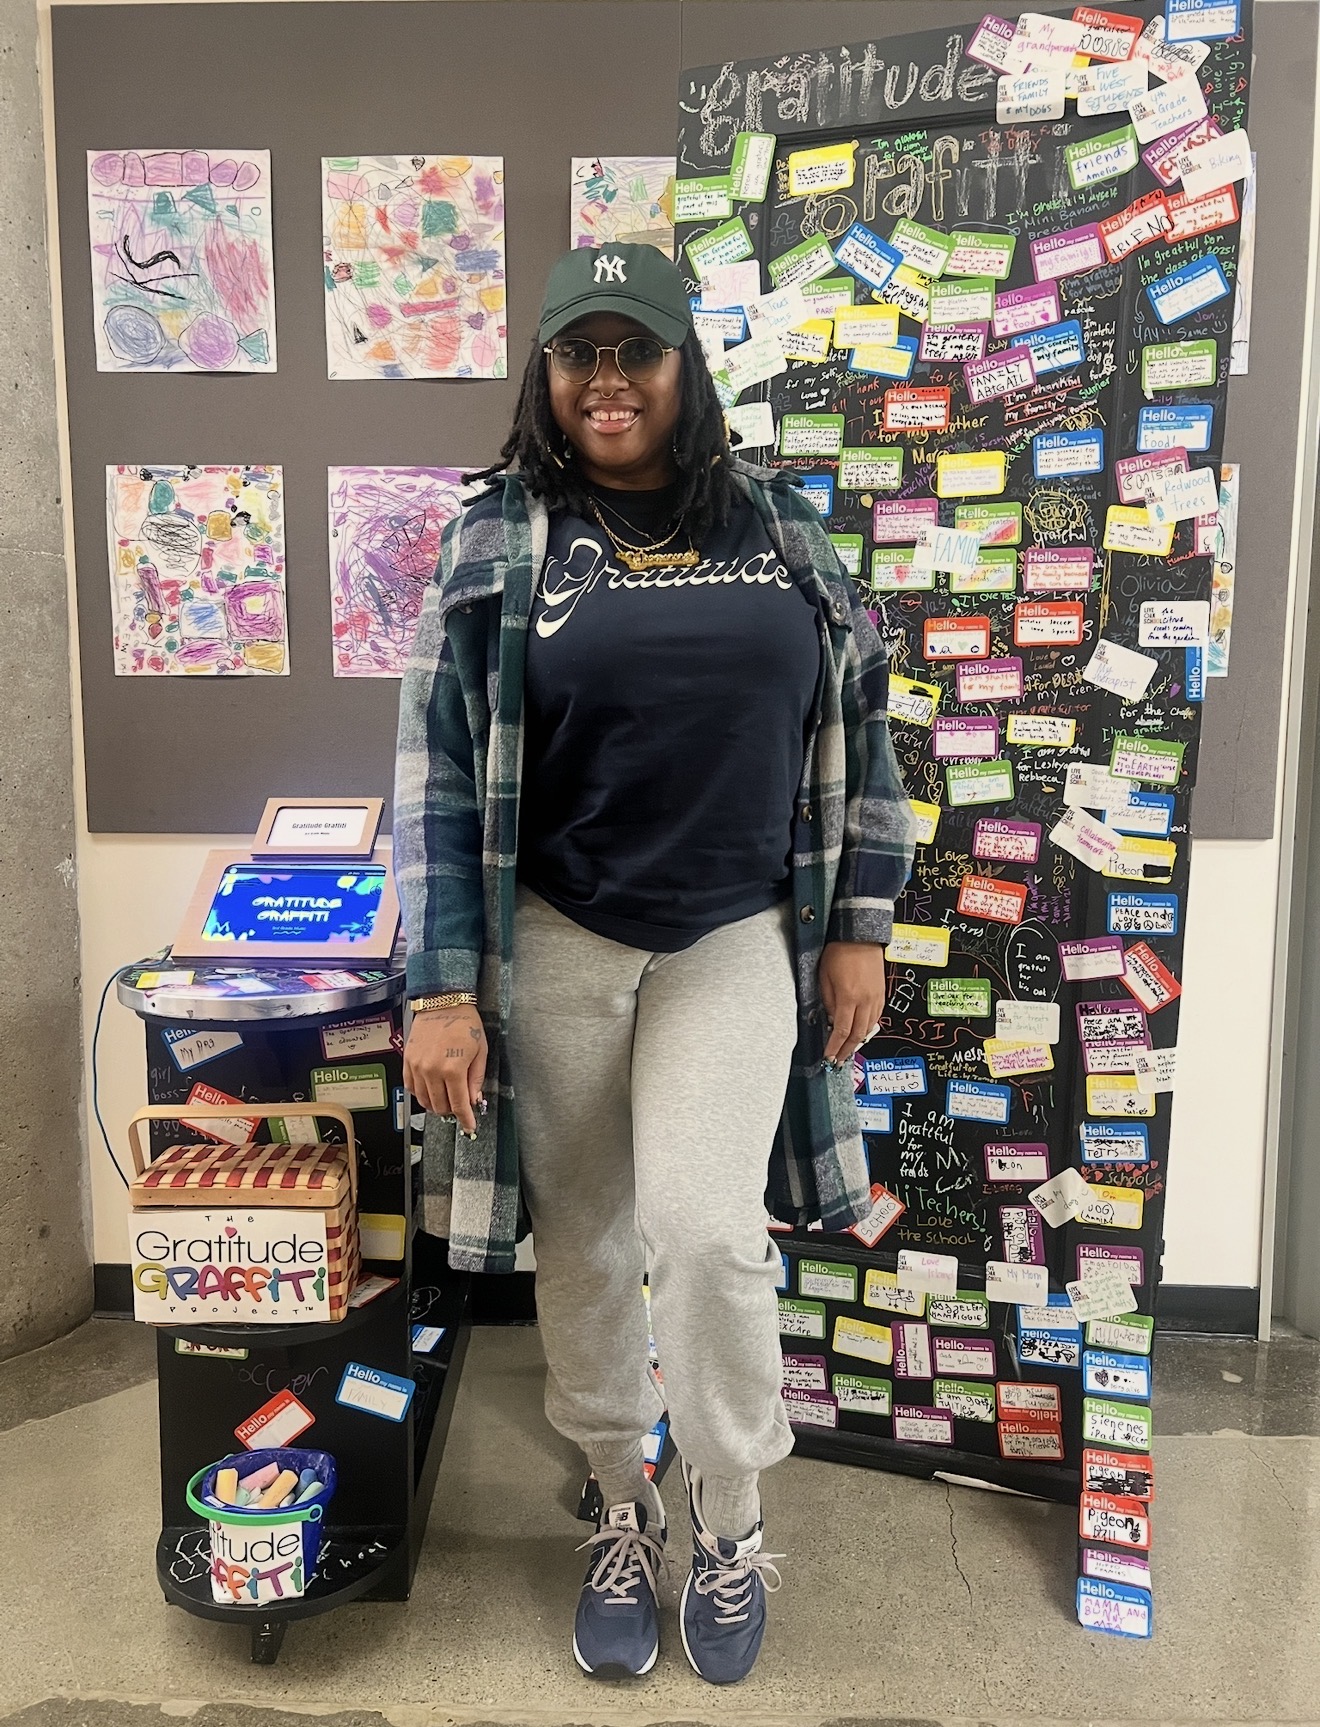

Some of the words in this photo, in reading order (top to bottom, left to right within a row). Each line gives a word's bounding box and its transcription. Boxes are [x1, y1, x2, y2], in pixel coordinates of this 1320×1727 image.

[1076, 11, 1108, 25] Hello
[983, 18, 1013, 39] Hello
[1039, 24, 1055, 39] My
[1013, 78, 1049, 91] FRIENDS
[1099, 77, 1129, 91] WEST
[1017, 88, 1048, 102] FAMILY
[1086, 87, 1145, 105] STUDENTS
[1014, 105, 1029, 114] MY
[1029, 105, 1052, 117] DOGS
[1158, 96, 1187, 113] Grade
[1151, 108, 1192, 130] Teachers
[1070, 139, 1102, 160] Hello
[1145, 136, 1178, 164] Hello
[1076, 147, 1128, 173] friends
[1209, 154, 1242, 170] Biking
[676, 182, 703, 193] Hello
[729, 165, 743, 196] Hello
[1025, 214, 1054, 229] Mini
[1060, 199, 1110, 223] Banana
[851, 228, 876, 249] Hello
[898, 223, 926, 240] Hello
[688, 236, 715, 255] Hello
[912, 244, 940, 259] grateful
[1034, 238, 1066, 254] Hello
[1138, 256, 1150, 271] I'm
[1204, 235, 1224, 246] for
[593, 253, 628, 284] NY
[772, 251, 799, 274] Hello
[1141, 274, 1159, 286] the
[1166, 260, 1188, 275] class
[931, 285, 962, 296] Hello
[1150, 277, 1183, 298] Hello
[995, 293, 1023, 309] Hello
[1013, 318, 1037, 328] food
[1177, 327, 1208, 341] Same
[1052, 344, 1079, 357] family
[1087, 352, 1102, 363] dog
[967, 361, 998, 376] Hello
[804, 378, 816, 387] my
[977, 374, 1028, 399] ABIGAIL
[888, 392, 917, 401] Hello
[1004, 393, 1027, 407] I'm
[1031, 376, 1081, 397] thankful
[1024, 401, 1057, 416] family
[1143, 410, 1176, 421] Hello
[786, 417, 814, 428] Hello
[878, 430, 900, 443] for
[1037, 437, 1068, 449] Hello
[1144, 434, 1176, 448] Food!
[842, 450, 872, 461] Hello
[1119, 460, 1151, 474] Hello
[1164, 471, 1211, 495] Redwood
[877, 503, 906, 514] Hello
[1170, 494, 1205, 512] trees
[875, 552, 904, 563] Hello
[1028, 552, 1059, 562] Hello
[535, 537, 794, 639] Gratitude
[1121, 575, 1187, 594] Olivia
[1018, 607, 1049, 616] Hello
[959, 663, 990, 676] Hello
[1189, 666, 1200, 698] Hello
[1037, 690, 1059, 704] my
[1119, 707, 1137, 719] for
[1144, 704, 1165, 716] the
[936, 720, 966, 731] Hello
[1133, 722, 1174, 738] grateful
[1117, 739, 1149, 751] Hello
[1016, 762, 1032, 771] for
[1131, 759, 1160, 772] EARTH
[949, 767, 979, 779] Hello
[978, 820, 1008, 833] Hello
[1076, 833, 1104, 856] teamwork
[1108, 853, 1144, 875] Pigeon
[917, 866, 940, 877] the
[252, 897, 342, 908] GRATITUDE
[1111, 895, 1144, 905] Hello
[256, 911, 330, 922] GRAFFITI
[1061, 944, 1090, 955] Hello
[1036, 954, 1051, 962] am
[930, 981, 959, 991] Hello
[180, 1046, 195, 1063] My
[866, 1060, 894, 1071] Hello
[151, 1066, 171, 1088] girl
[314, 1071, 349, 1083] Hello
[152, 1088, 180, 1100] boss
[950, 1082, 979, 1094] Hello
[901, 1103, 912, 1117] I
[927, 1111, 955, 1130] am
[898, 1121, 954, 1146] grateful
[907, 1138, 922, 1151] for
[987, 1146, 1017, 1156] Hello
[900, 1151, 924, 1169] my
[1053, 1189, 1063, 1201] My
[916, 1216, 953, 1227] Love
[897, 1228, 922, 1242] the
[926, 1231, 976, 1245] School
[136, 1226, 324, 1263] Gratitude
[1080, 1247, 1110, 1258] Hello
[802, 1262, 829, 1274] Hello
[921, 1257, 940, 1266] Love
[1006, 1269, 1019, 1280] My
[1022, 1270, 1042, 1280] Mom
[935, 1339, 964, 1350] Hello
[896, 1349, 907, 1376] Hello
[1086, 1354, 1117, 1367] Hello
[229, 1361, 330, 1396] occer
[348, 1364, 381, 1383] Hello
[835, 1377, 863, 1388] Hello
[783, 1390, 811, 1402] Hello
[895, 1407, 923, 1418] Hello
[1087, 1401, 1117, 1413] Hello
[1000, 1423, 1030, 1433] Hello
[1086, 1453, 1118, 1466] Hello
[1085, 1598, 1121, 1612] MAMA
